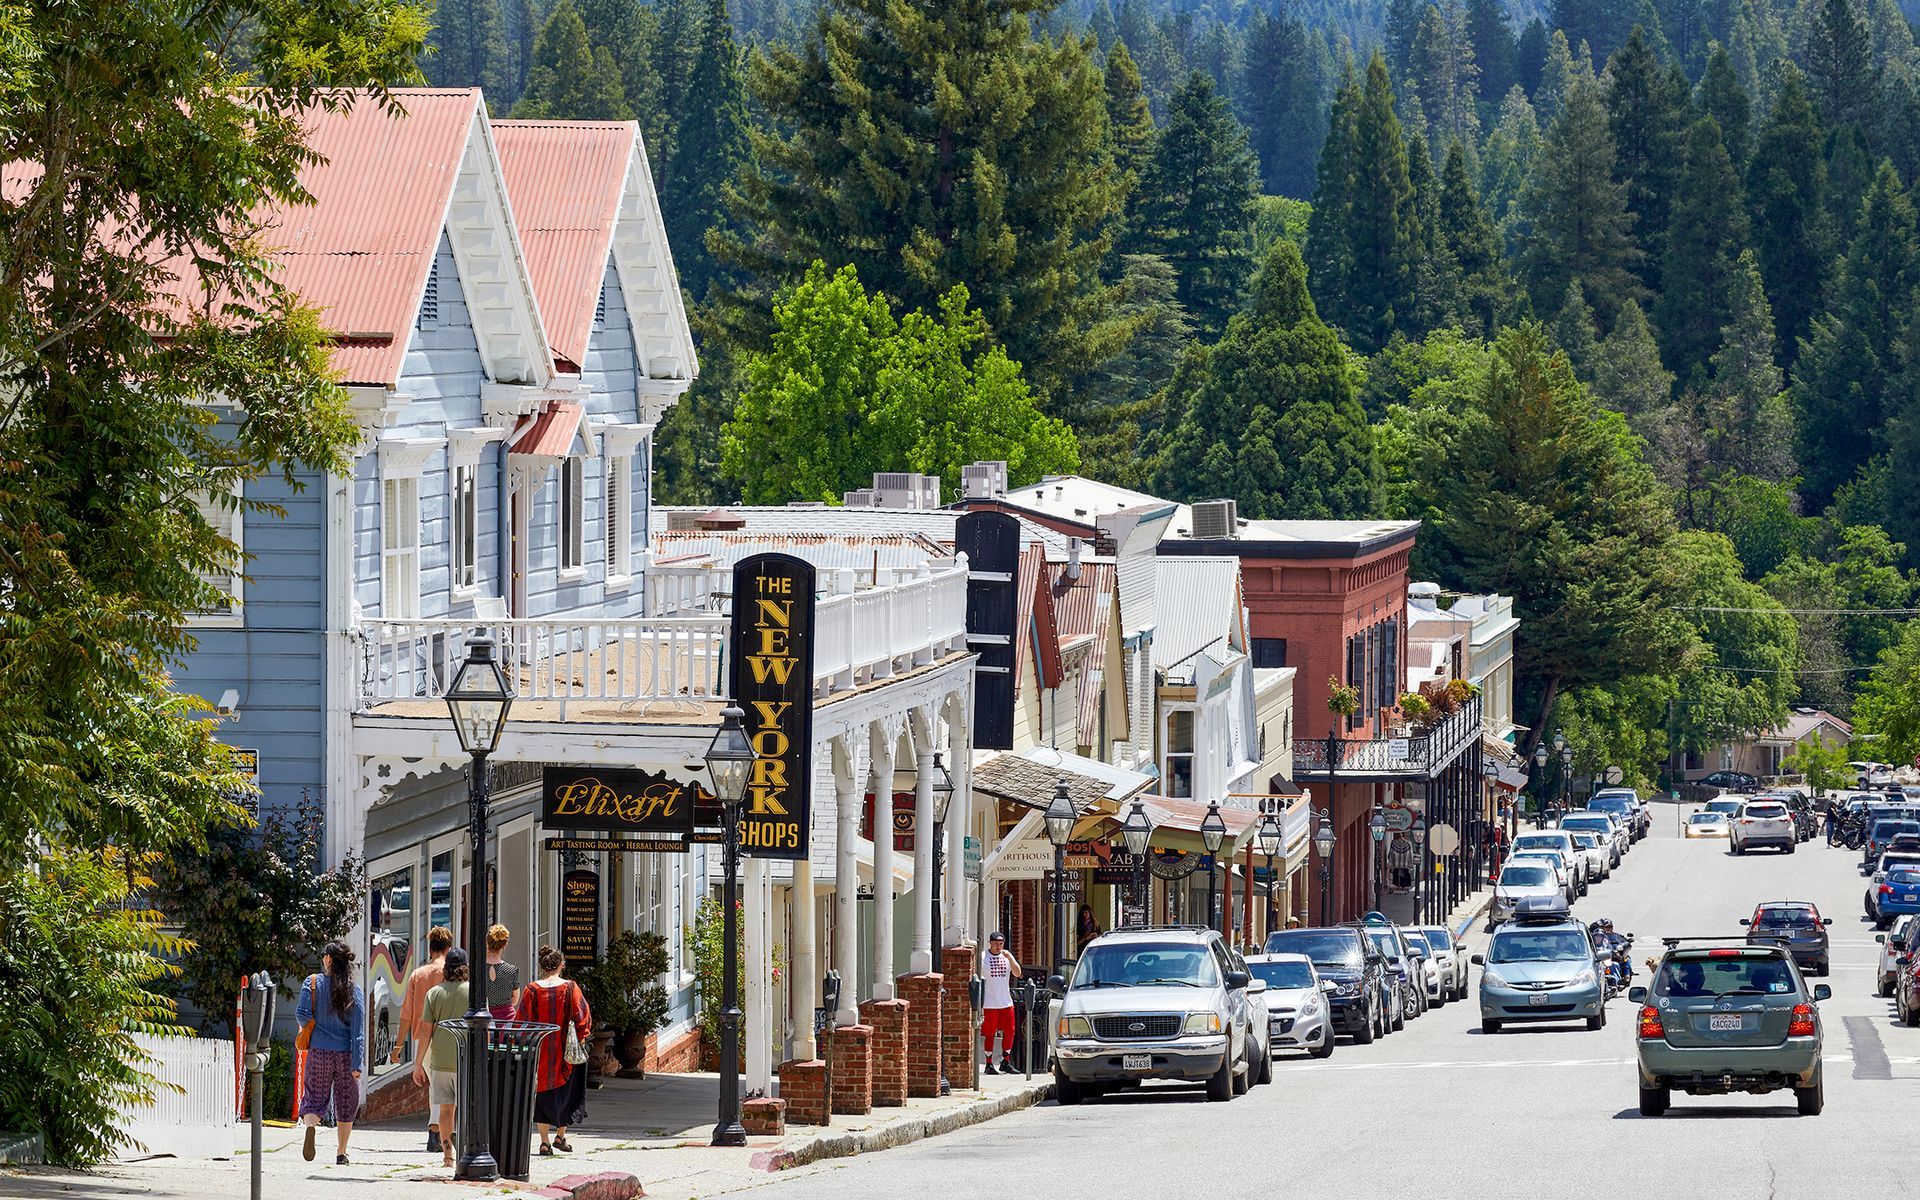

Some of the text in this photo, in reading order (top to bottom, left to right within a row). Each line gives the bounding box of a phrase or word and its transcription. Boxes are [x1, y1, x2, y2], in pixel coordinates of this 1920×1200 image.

[756, 576, 792, 594] THE
[745, 599, 799, 815] NEW YORK
[552, 777, 683, 823] Elixart
[737, 820, 799, 848] SHOPS
[550, 840, 684, 850] ART TASTING ROOM HERBAL LOUNGE
[1070, 857, 1090, 866] YORK
[1068, 870, 1079, 880] TO
[566, 880, 596, 892] Shops
[1051, 893, 1076, 901] SOPS
[567, 936, 593, 944] SAVVY
[1711, 1020, 1740, 1029] 6ACG240
